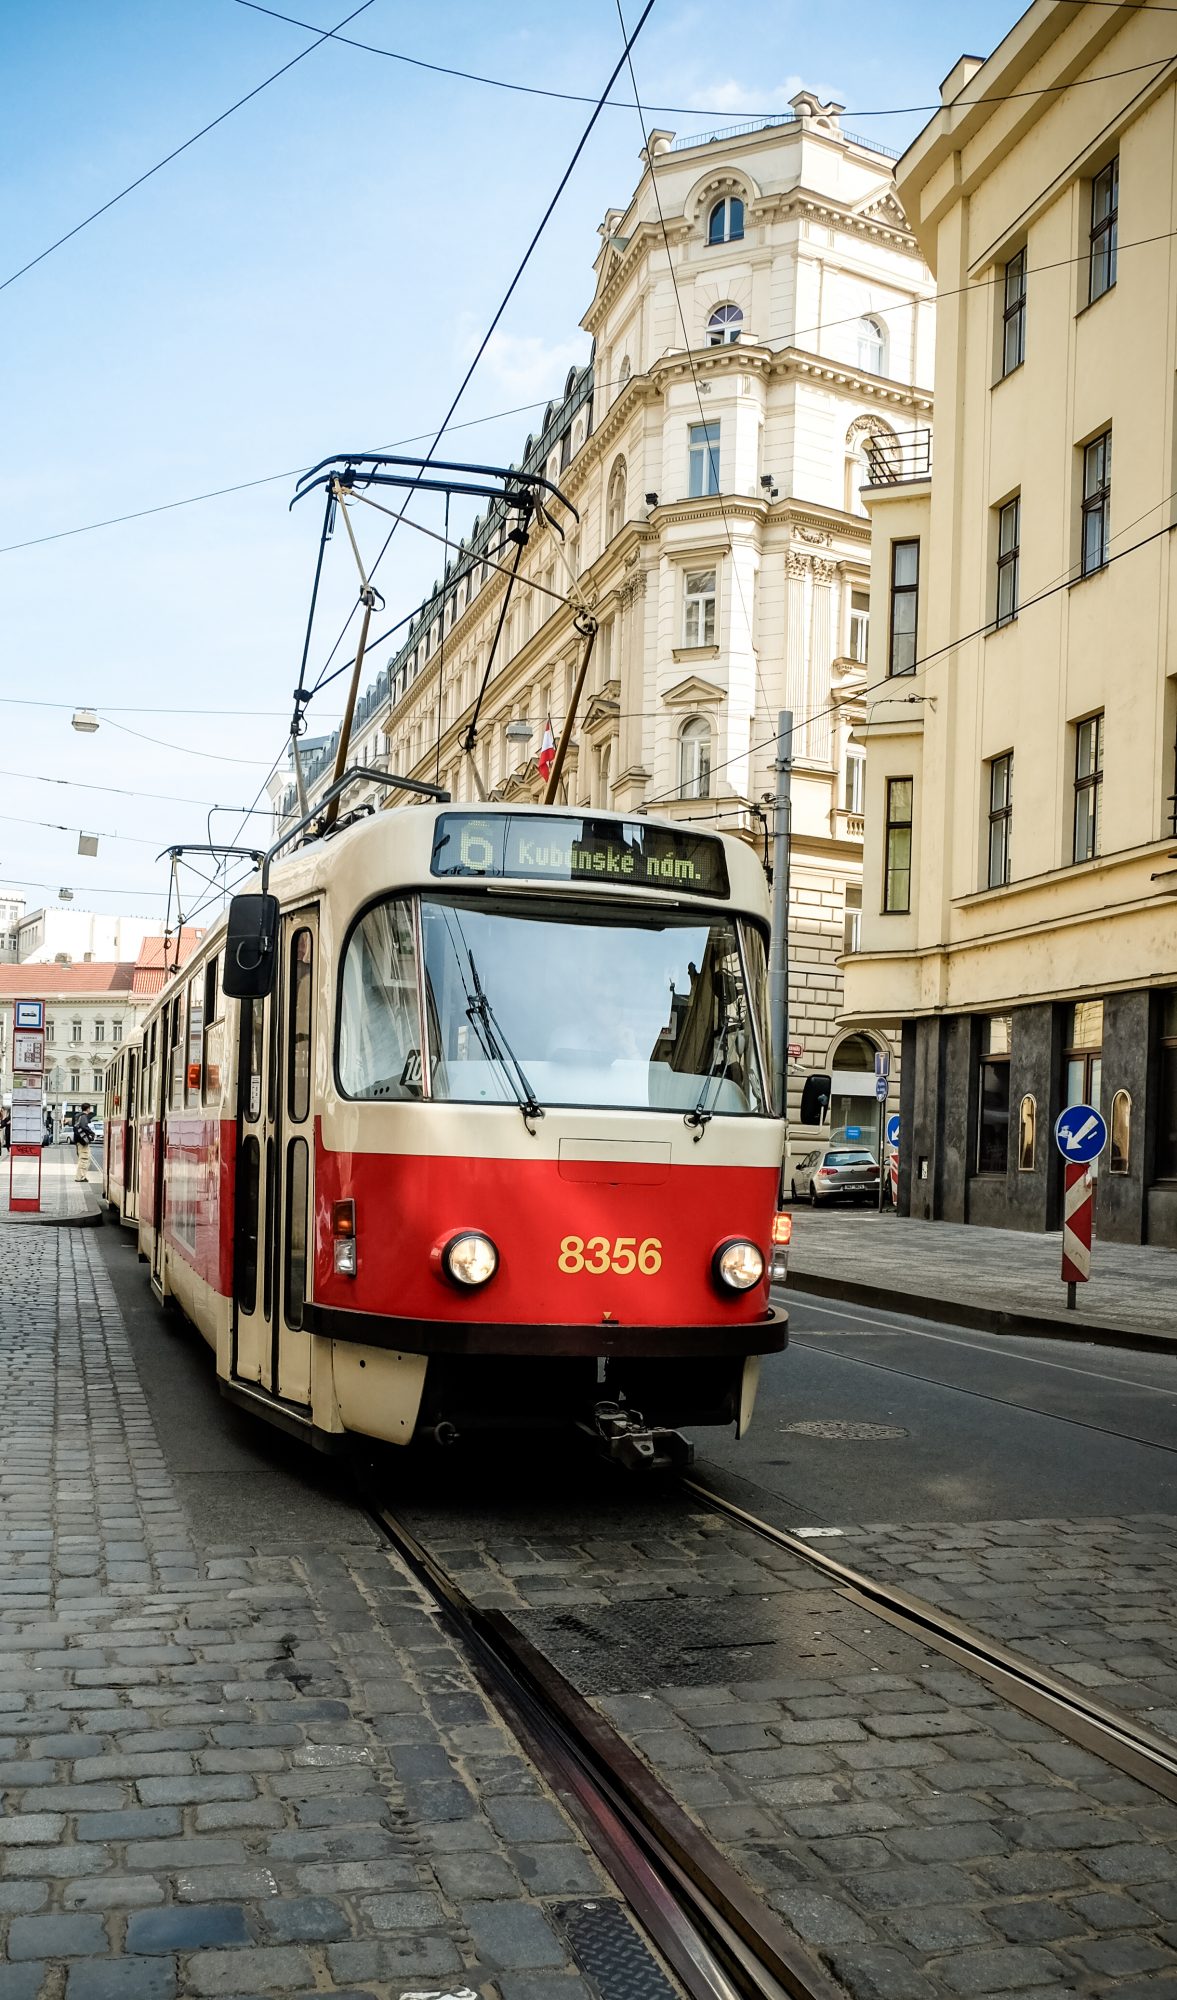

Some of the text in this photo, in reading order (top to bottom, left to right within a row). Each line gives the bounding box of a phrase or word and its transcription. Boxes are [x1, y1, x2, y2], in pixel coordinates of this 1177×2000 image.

[459, 820, 494, 871] 6
[518, 837, 702, 880] Kubánské nám.
[558, 1235, 663, 1276] 8356
